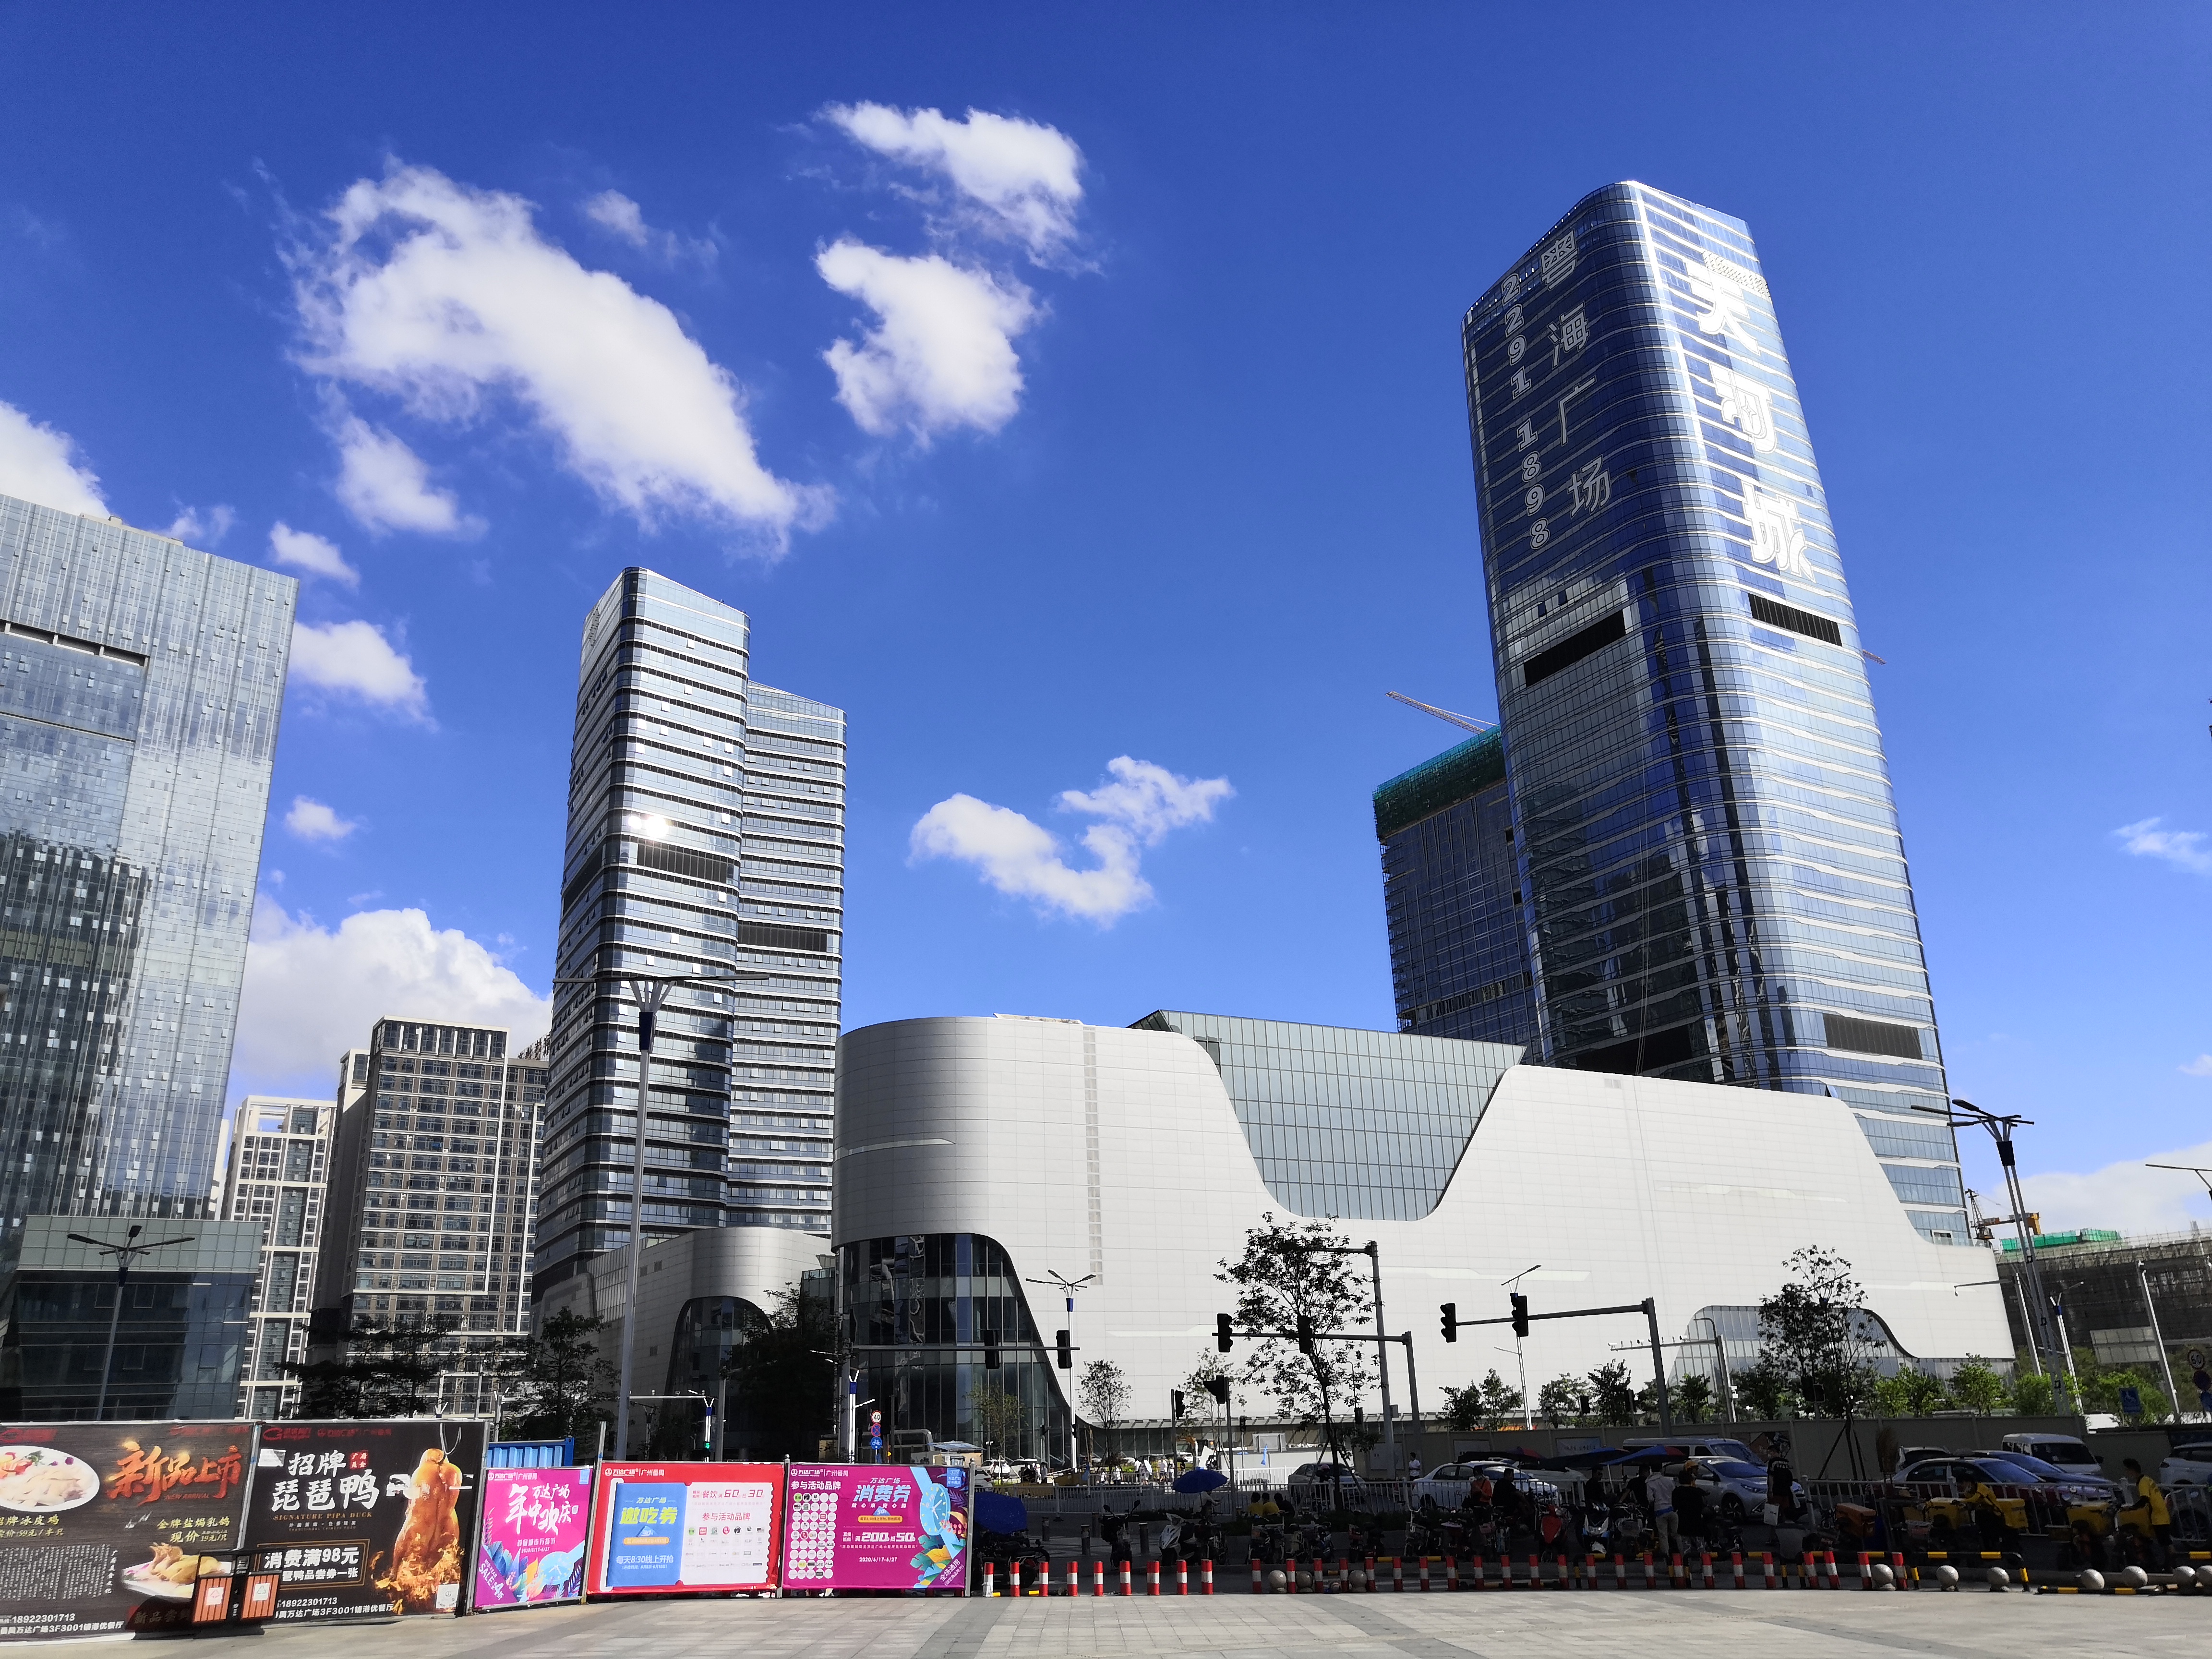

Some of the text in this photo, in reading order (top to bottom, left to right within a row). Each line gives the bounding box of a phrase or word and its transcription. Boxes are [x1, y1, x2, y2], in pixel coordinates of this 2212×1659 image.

[1541, 229, 1611, 517] 粤海广场
[1684, 249, 1817, 583] 天河城
[2191, 1355, 2201, 1364] 60
[288, 1450, 346, 1477] 招牌
[106, 1441, 241, 1506] 新品上市
[271, 1469, 380, 1512] 琵琶鸭
[532, 1483, 570, 1500] 万达广场
[791, 1480, 841, 1490] 参与活动品牌
[853, 1485, 911, 1502] 消费券
[505, 1483, 572, 1536] 年中欢庆
[619, 1507, 678, 1524] 邀吃券
[702, 1512, 750, 1521] 参与活动品牌
[156, 1516, 230, 1529] 金牌盐焗乳鸽
[264, 1547, 360, 1568] 消费满98元
[479, 1563, 494, 1586] SALE
[940, 1559, 961, 1582] 全场通用
[282, 1597, 337, 1608] 18922301713
[12, 1613, 75, 1623] 18922301713
